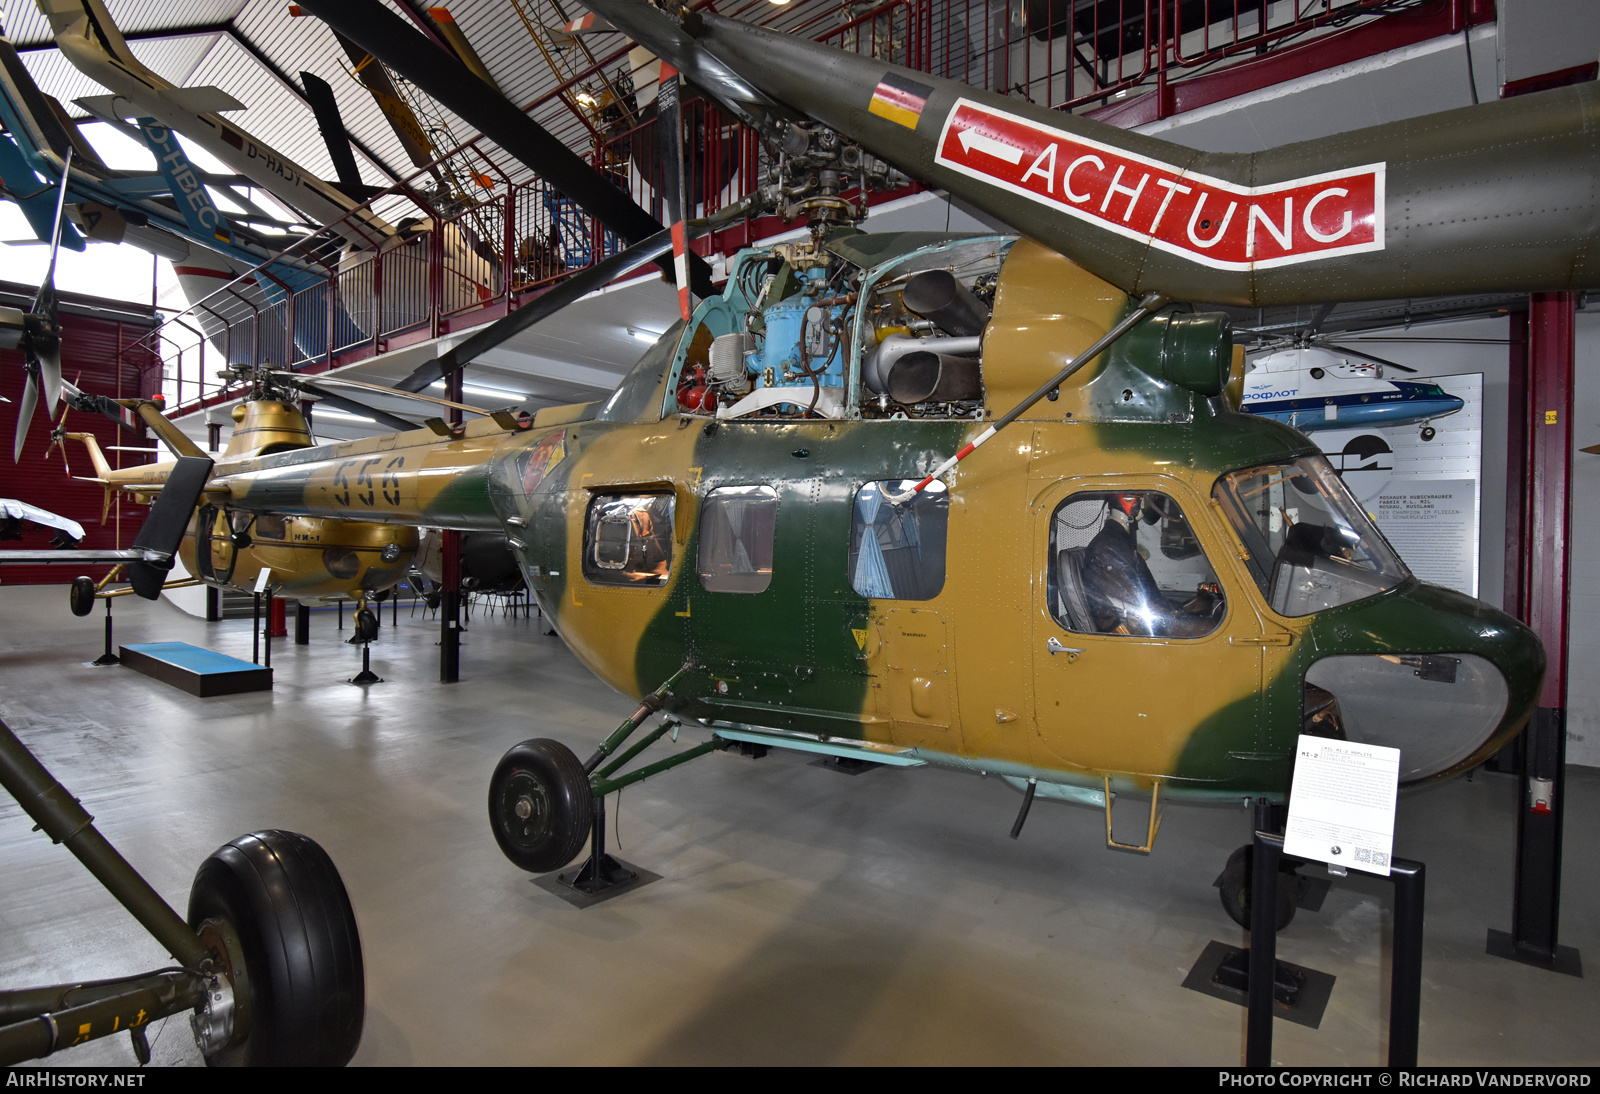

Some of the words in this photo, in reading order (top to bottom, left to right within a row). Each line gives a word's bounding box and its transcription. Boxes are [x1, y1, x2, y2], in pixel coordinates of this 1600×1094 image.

[145, 121, 219, 229] D-HBEC
[247, 142, 302, 187] D-HAJY
[1020, 142, 1354, 259] ACHTUNG
[1546, 414, 1557, 422] 33
[333, 456, 404, 507] 556
